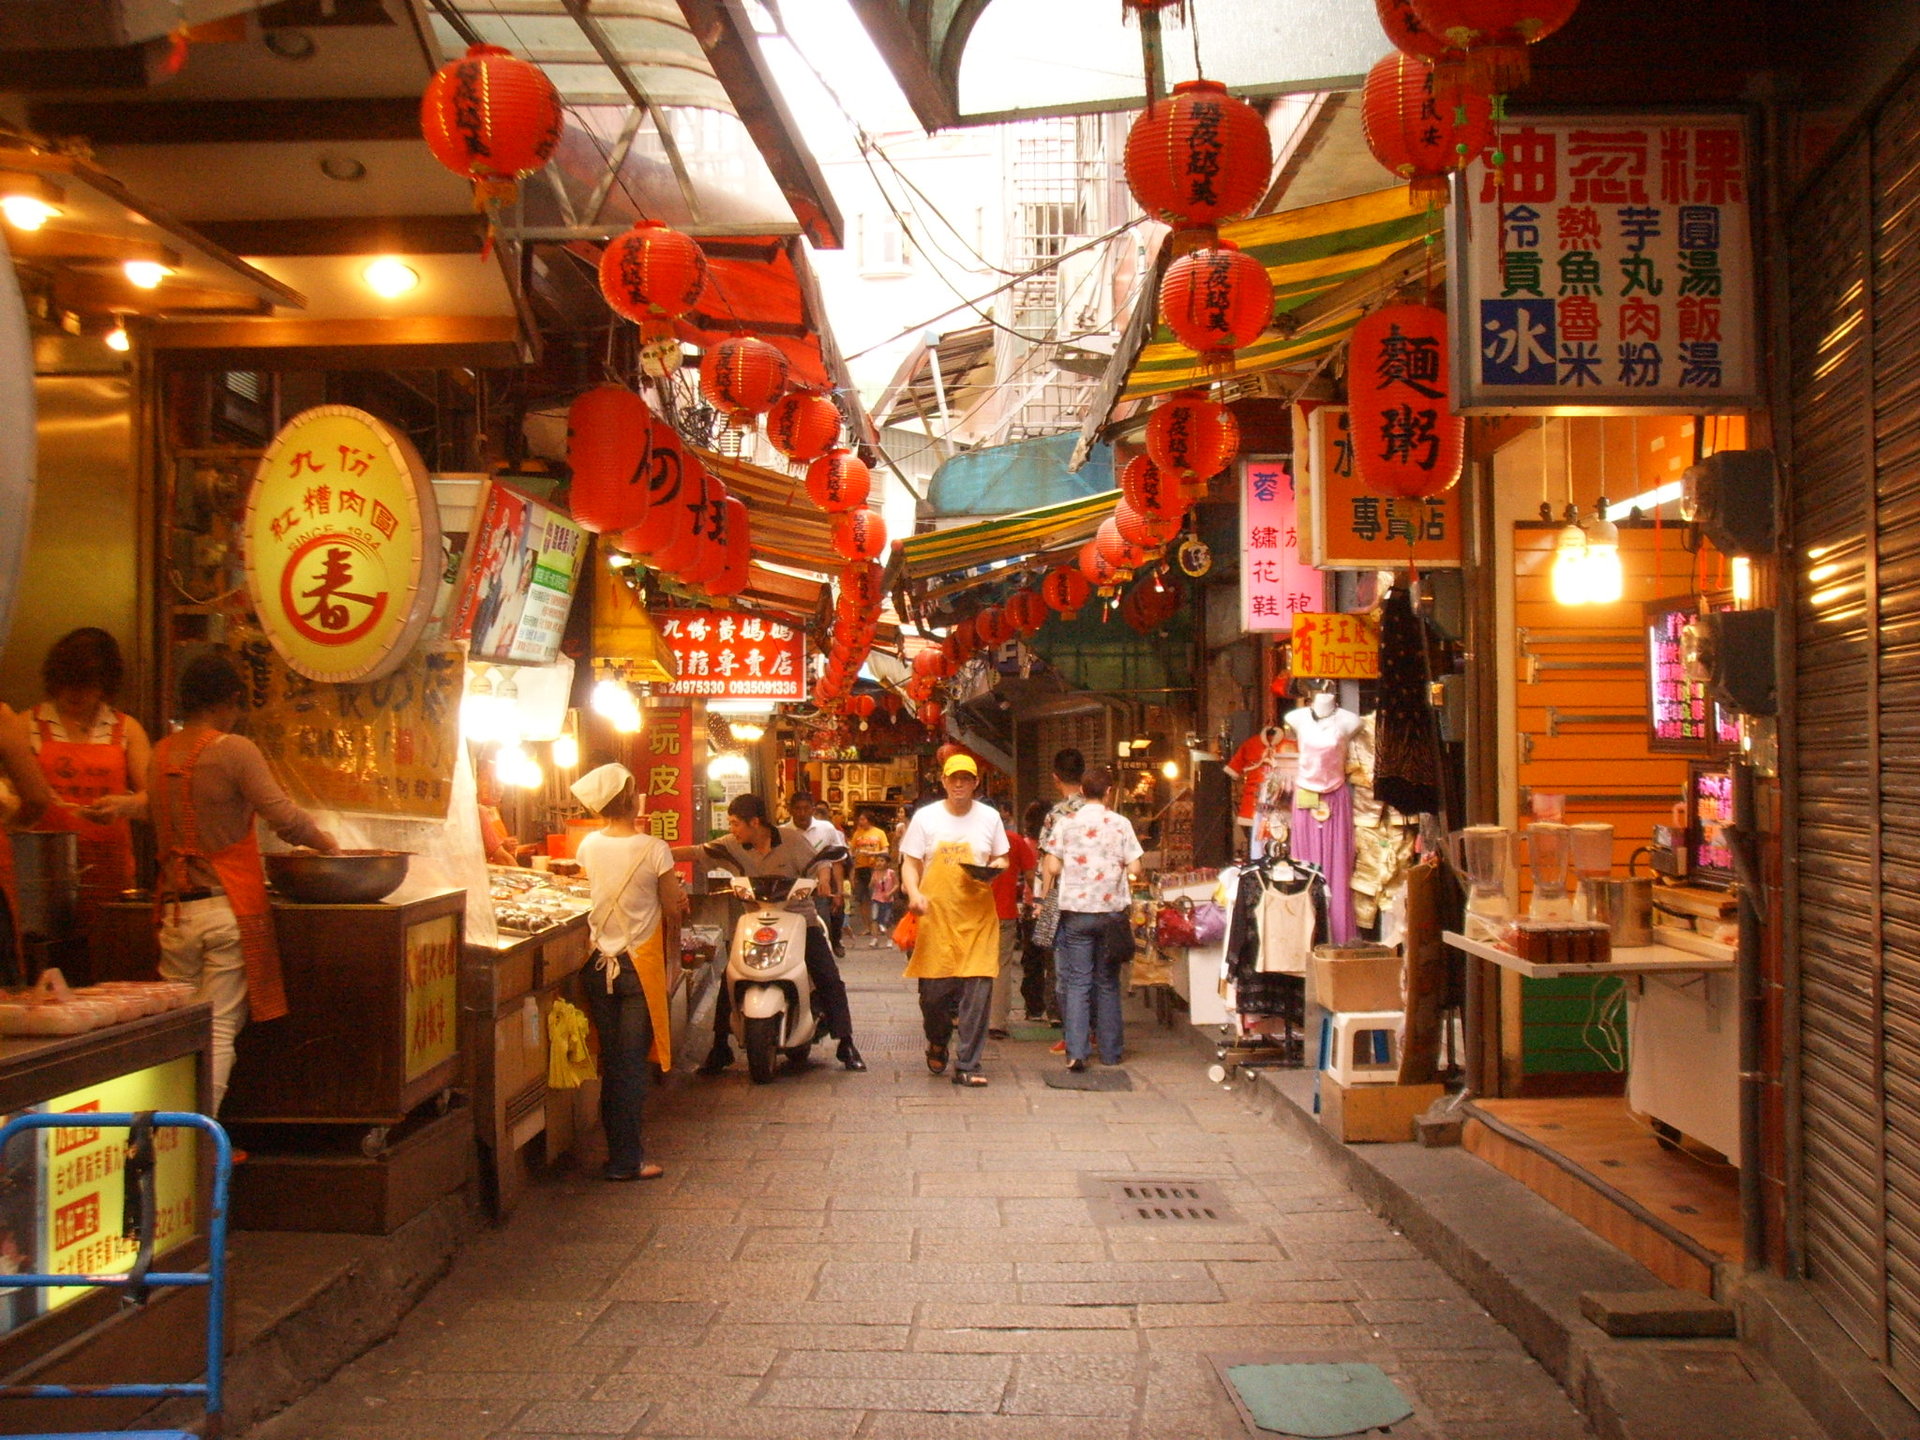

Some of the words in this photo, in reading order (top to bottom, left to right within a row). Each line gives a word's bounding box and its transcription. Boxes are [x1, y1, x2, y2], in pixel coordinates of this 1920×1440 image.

[1484, 306, 1556, 375] 冰
[1558, 342, 1723, 388] 米粉湯
[1377, 323, 1446, 471] 麵粥
[289, 444, 376, 479] 九份
[288, 524, 334, 552] SINCE
[1250, 526, 1281, 617] 繡花鞋
[1294, 616, 1317, 674] 有
[668, 681, 725, 695] 24975330
[729, 681, 798, 695] 0935091336
